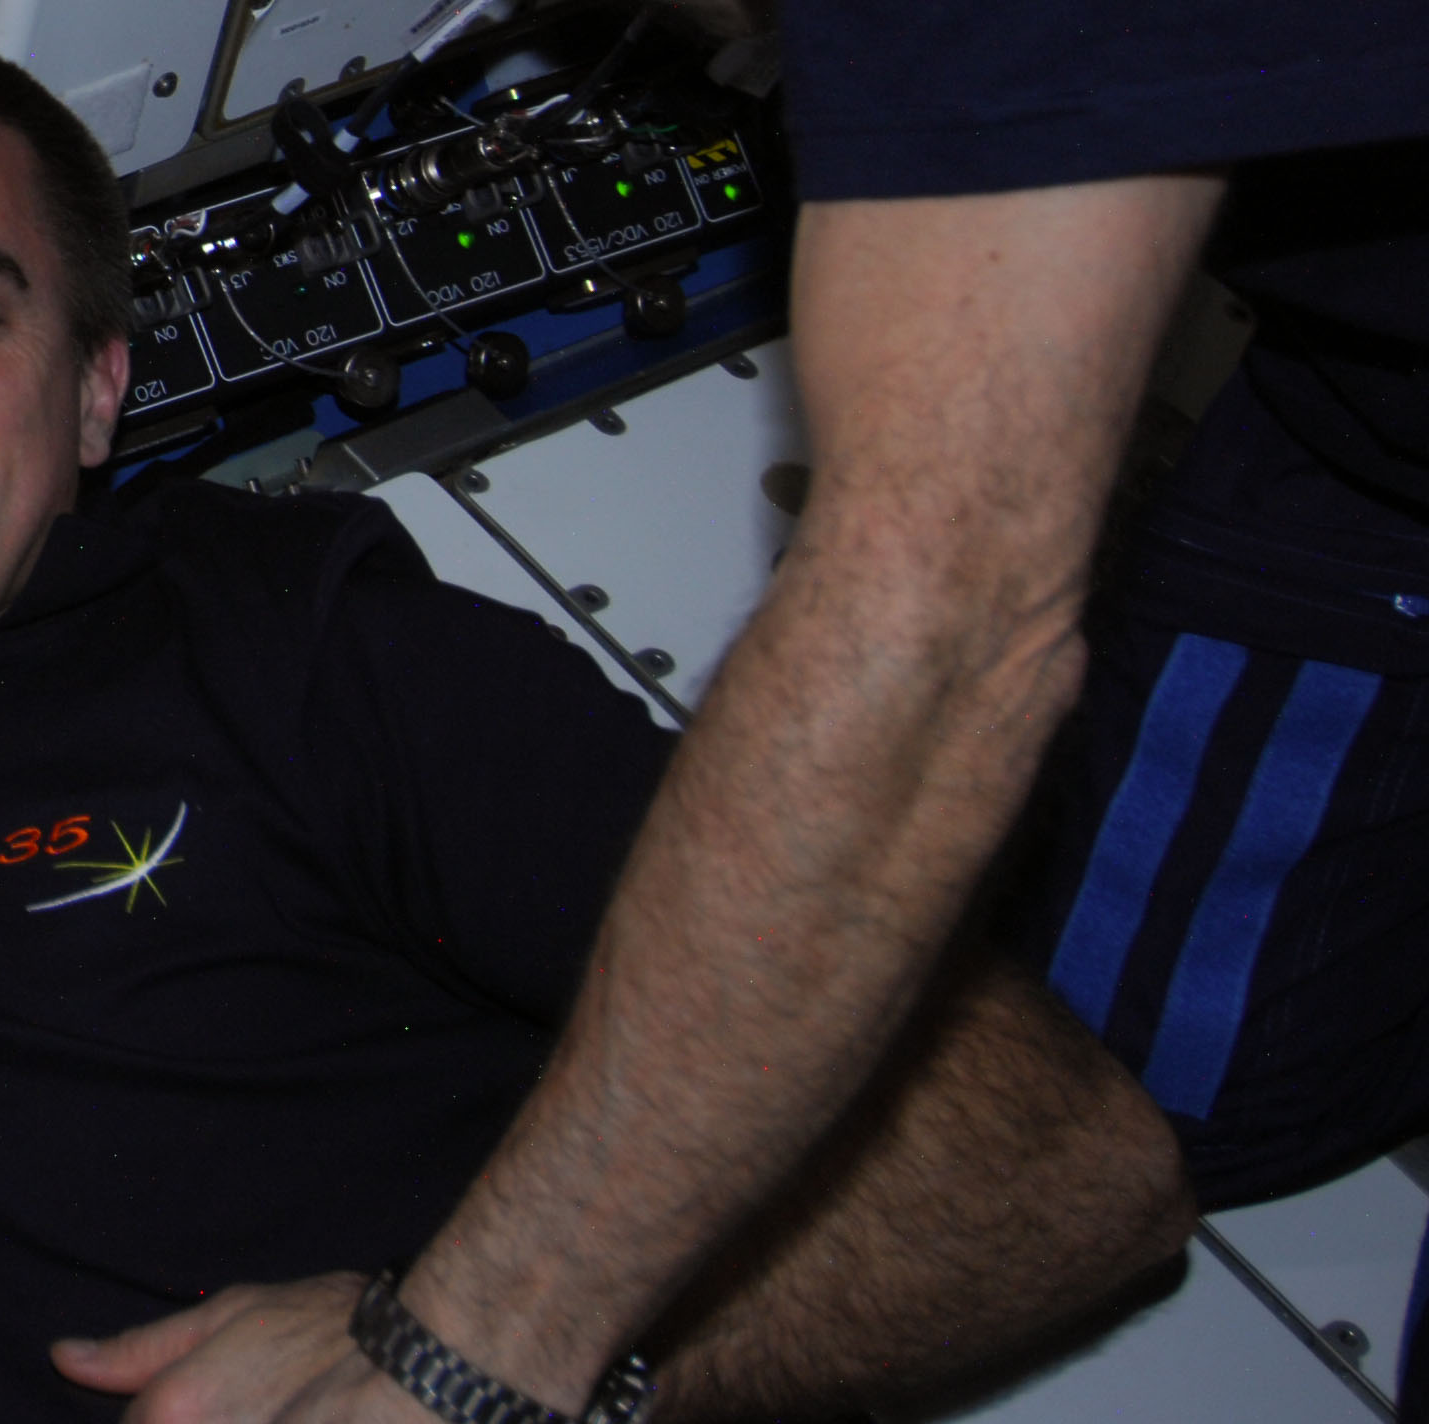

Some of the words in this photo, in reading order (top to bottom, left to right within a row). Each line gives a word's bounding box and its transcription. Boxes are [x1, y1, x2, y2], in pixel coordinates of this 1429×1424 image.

[644, 168, 668, 186] ON
[395, 217, 419, 237] J2
[485, 218, 511, 237] ON
[229, 270, 253, 289] J3
[322, 270, 348, 289] ON
[426, 284, 466, 306] VDC
[154, 325, 179, 344] ON
